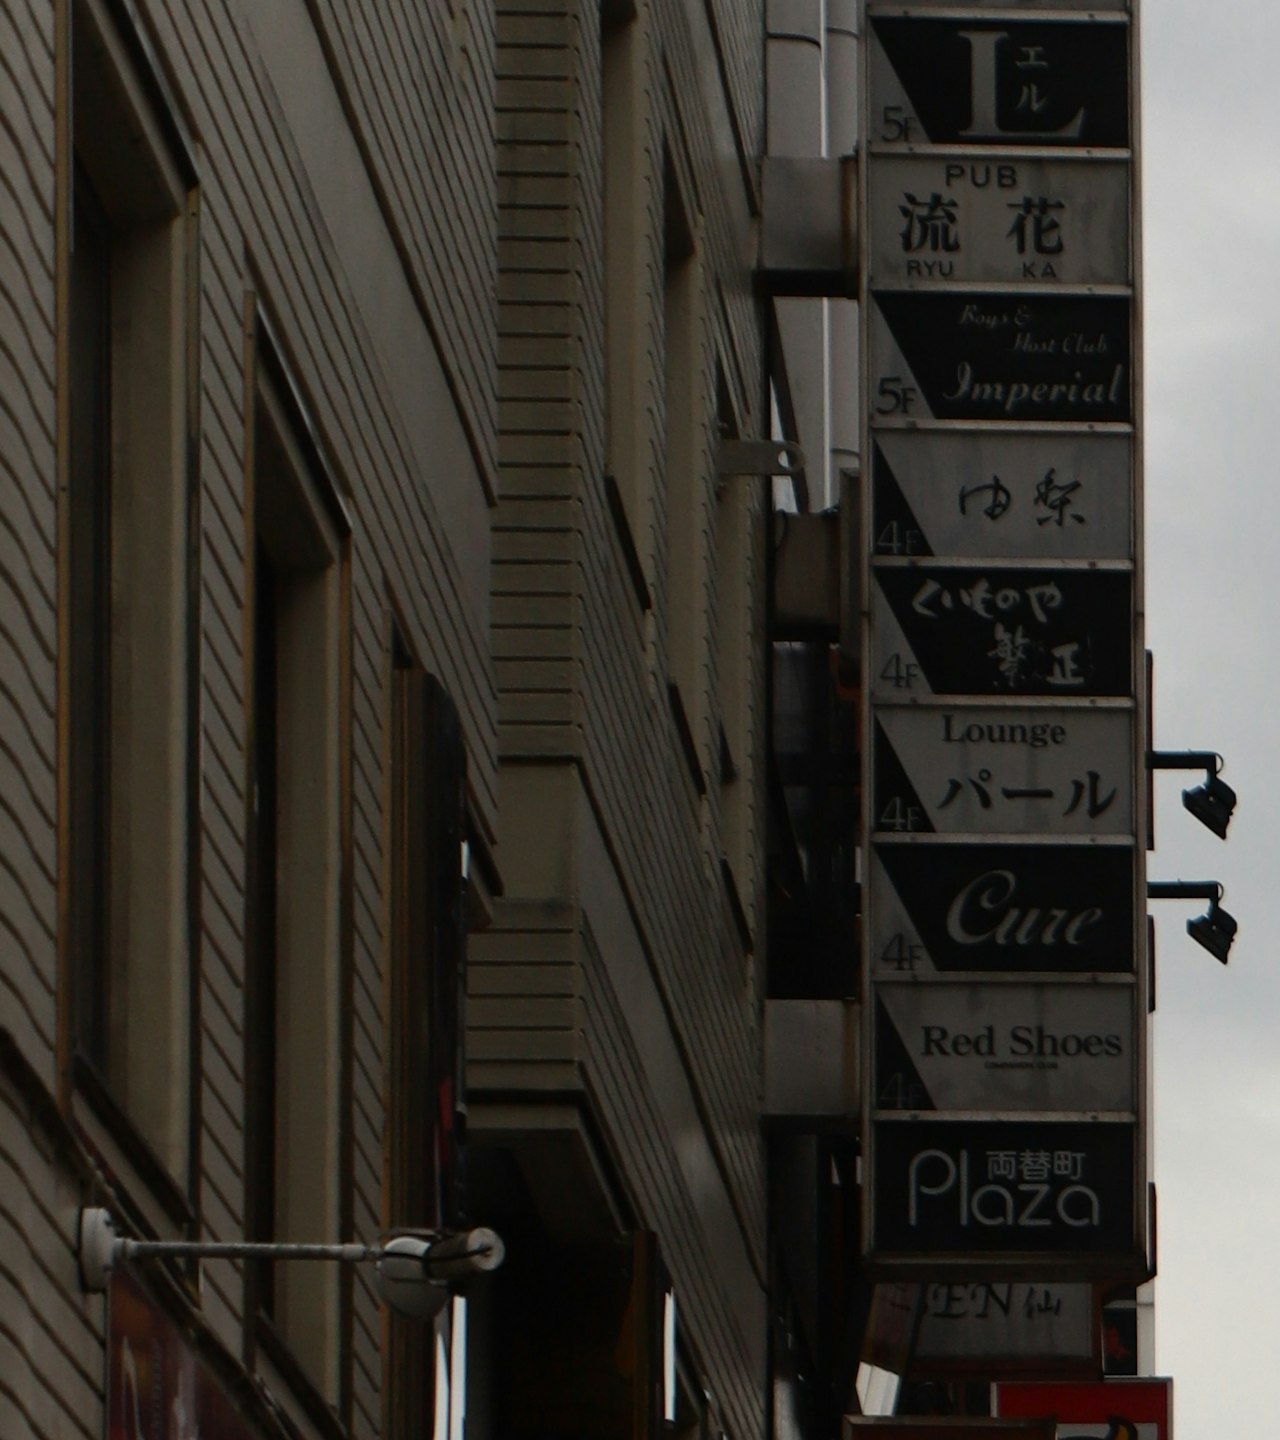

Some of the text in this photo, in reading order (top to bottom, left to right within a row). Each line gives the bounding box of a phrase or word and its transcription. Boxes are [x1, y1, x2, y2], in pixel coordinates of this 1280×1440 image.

[957, 30, 1087, 140] L
[1015, 43, 1049, 113] エル
[881, 106, 917, 144] 5F
[945, 165, 1018, 187] PUB
[906, 260, 1058, 279] RYU KA
[1013, 331, 1109, 356] Host Club
[875, 376, 916, 415] 5F
[941, 361, 1125, 412] Imperial
[876, 519, 920, 555] 4F
[911, 576, 1065, 624] くいものや
[879, 652, 920, 689] 4F
[941, 713, 1067, 747] Lounge
[937, 768, 1118, 820] パール
[880, 795, 922, 832] 4F
[945, 868, 1106, 947] Cure
[880, 932, 923, 971] 4F
[921, 1024, 1123, 1059] Red Shoes
[879, 1072, 923, 1109] 4F
[984, 1149, 1087, 1182] 両替町
[907, 1147, 1101, 1227] Plaza
